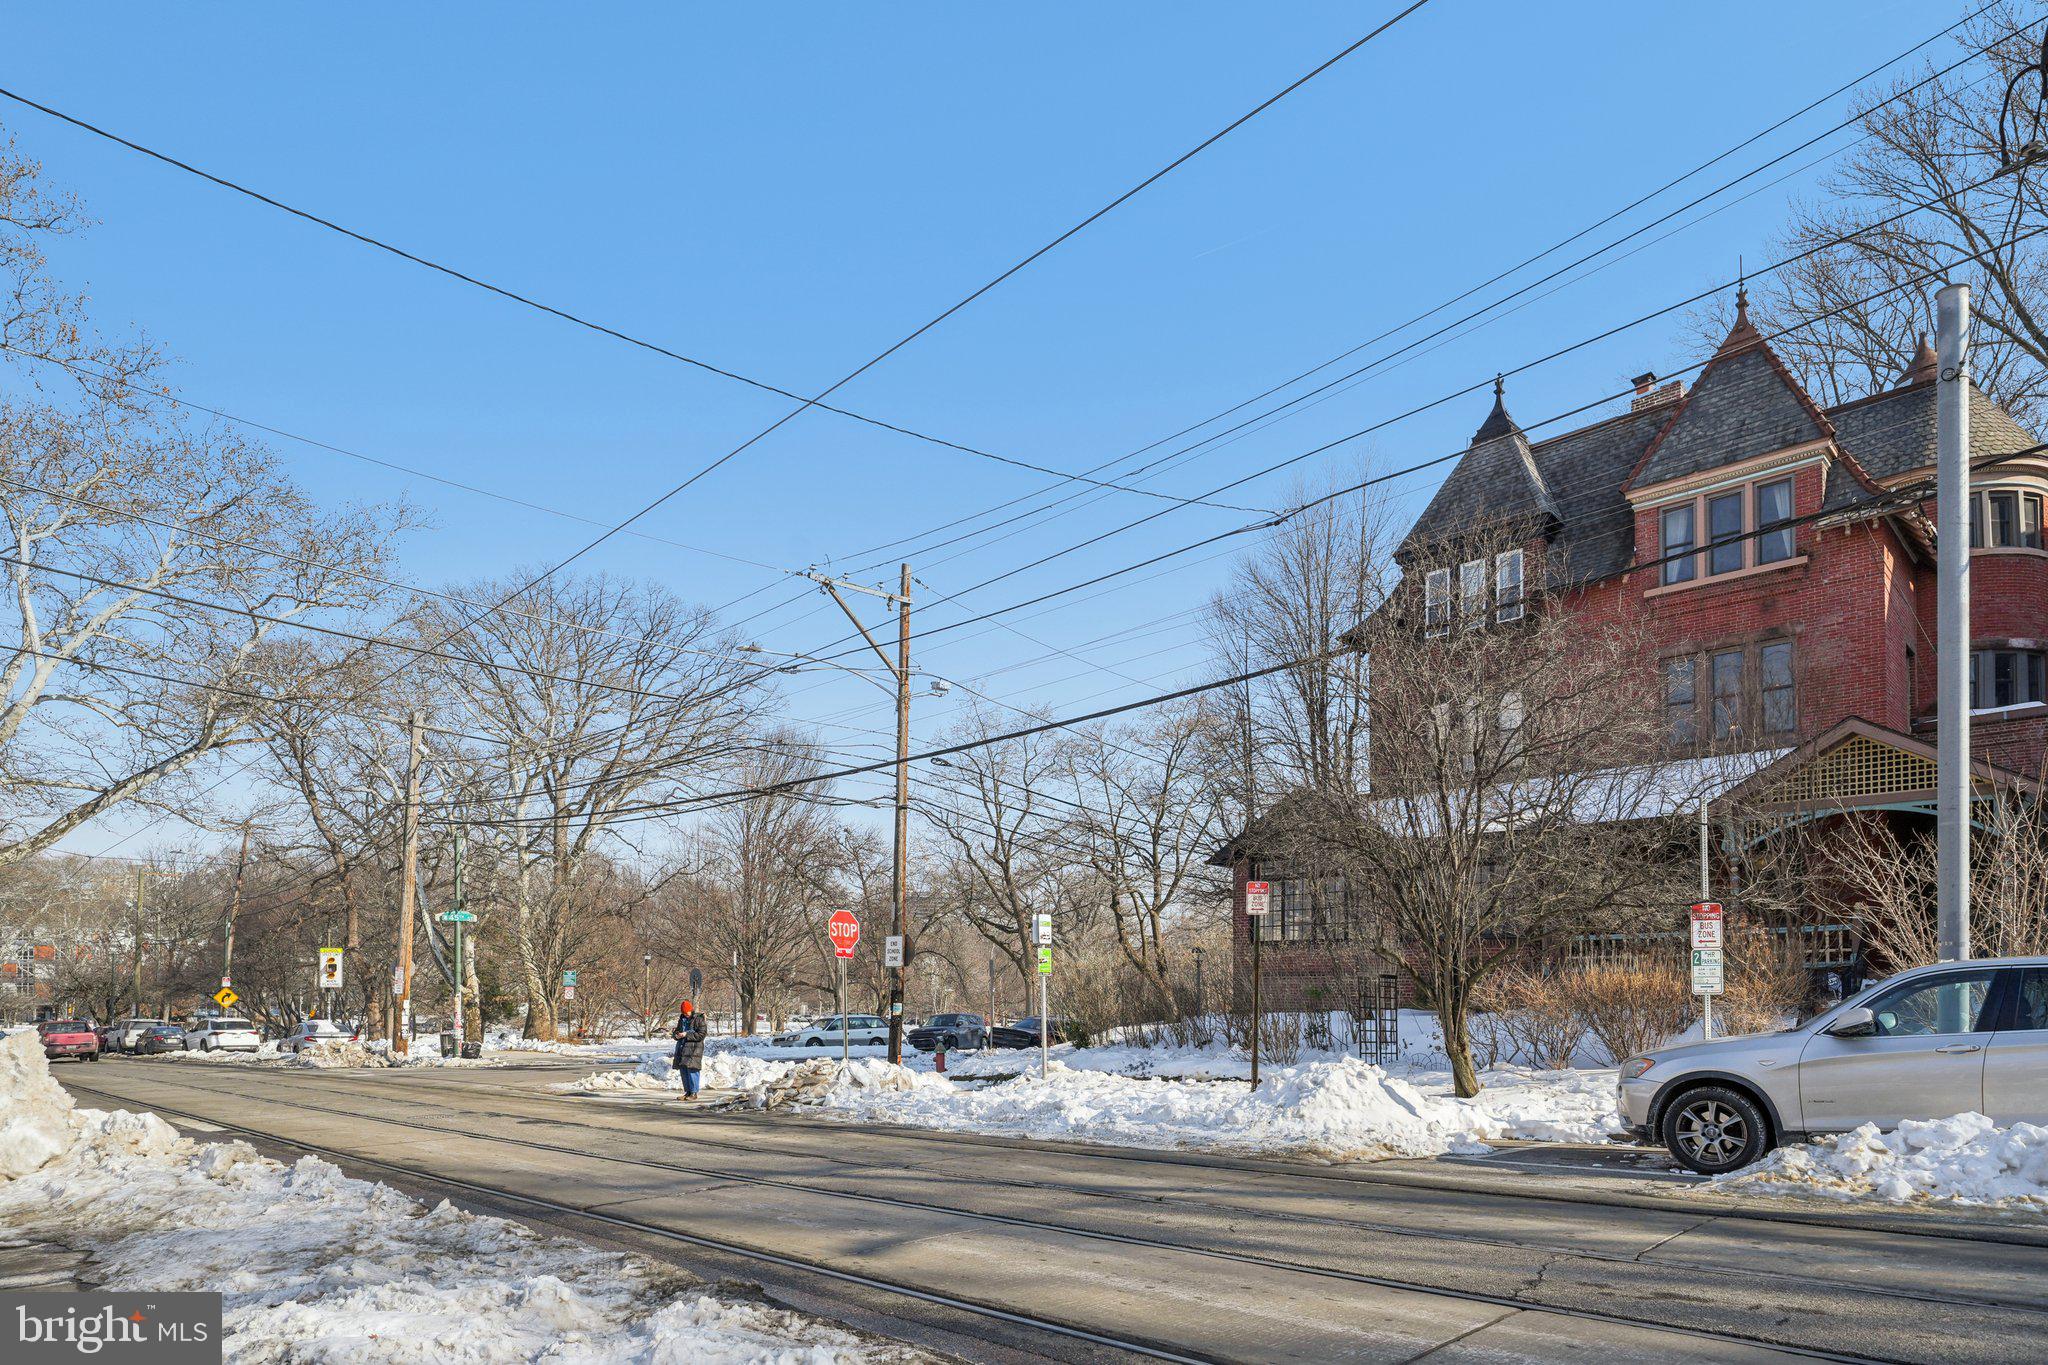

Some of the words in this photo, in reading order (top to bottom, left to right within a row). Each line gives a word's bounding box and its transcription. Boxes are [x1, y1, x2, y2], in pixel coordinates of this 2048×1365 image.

[831, 922, 857, 937] STOP
[1700, 922, 1713, 930] BUS
[1694, 952, 1700, 964] 2
